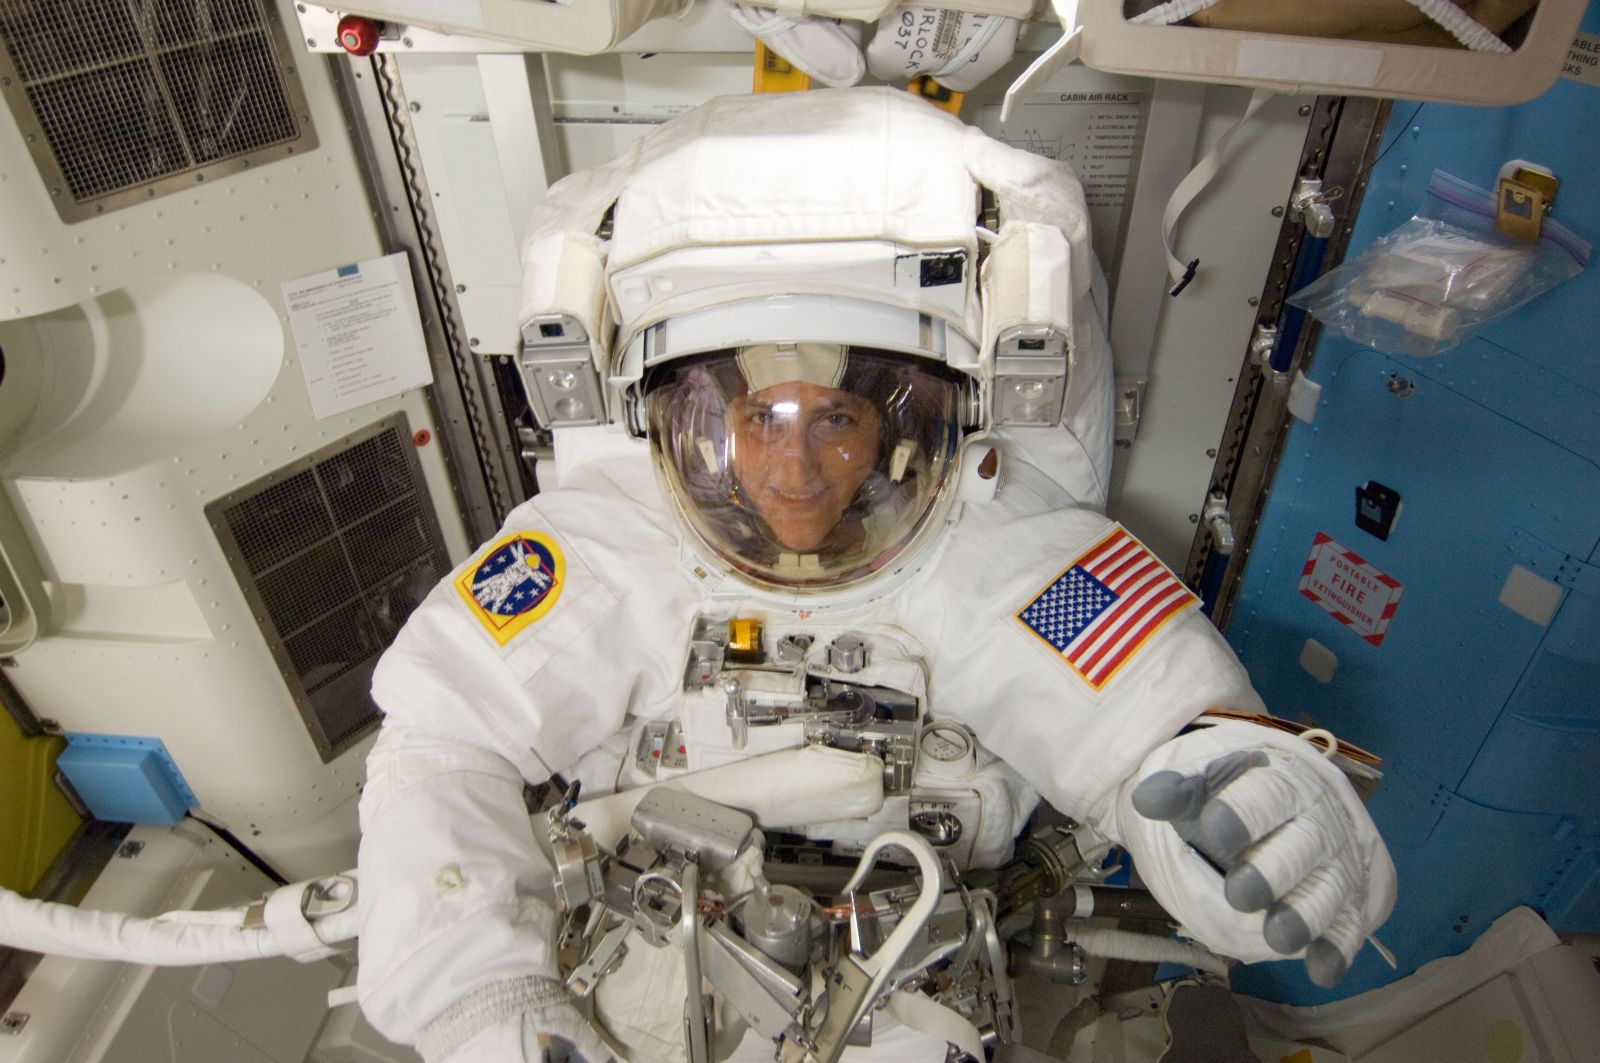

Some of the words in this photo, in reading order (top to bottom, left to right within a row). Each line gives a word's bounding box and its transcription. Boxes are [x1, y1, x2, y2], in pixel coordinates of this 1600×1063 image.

[1104, 93, 1129, 101] RACK
[1330, 555, 1379, 592] PORTABLE
[1331, 573, 1366, 604] FIRE
[1313, 580, 1373, 626] EXTINGUISHER
